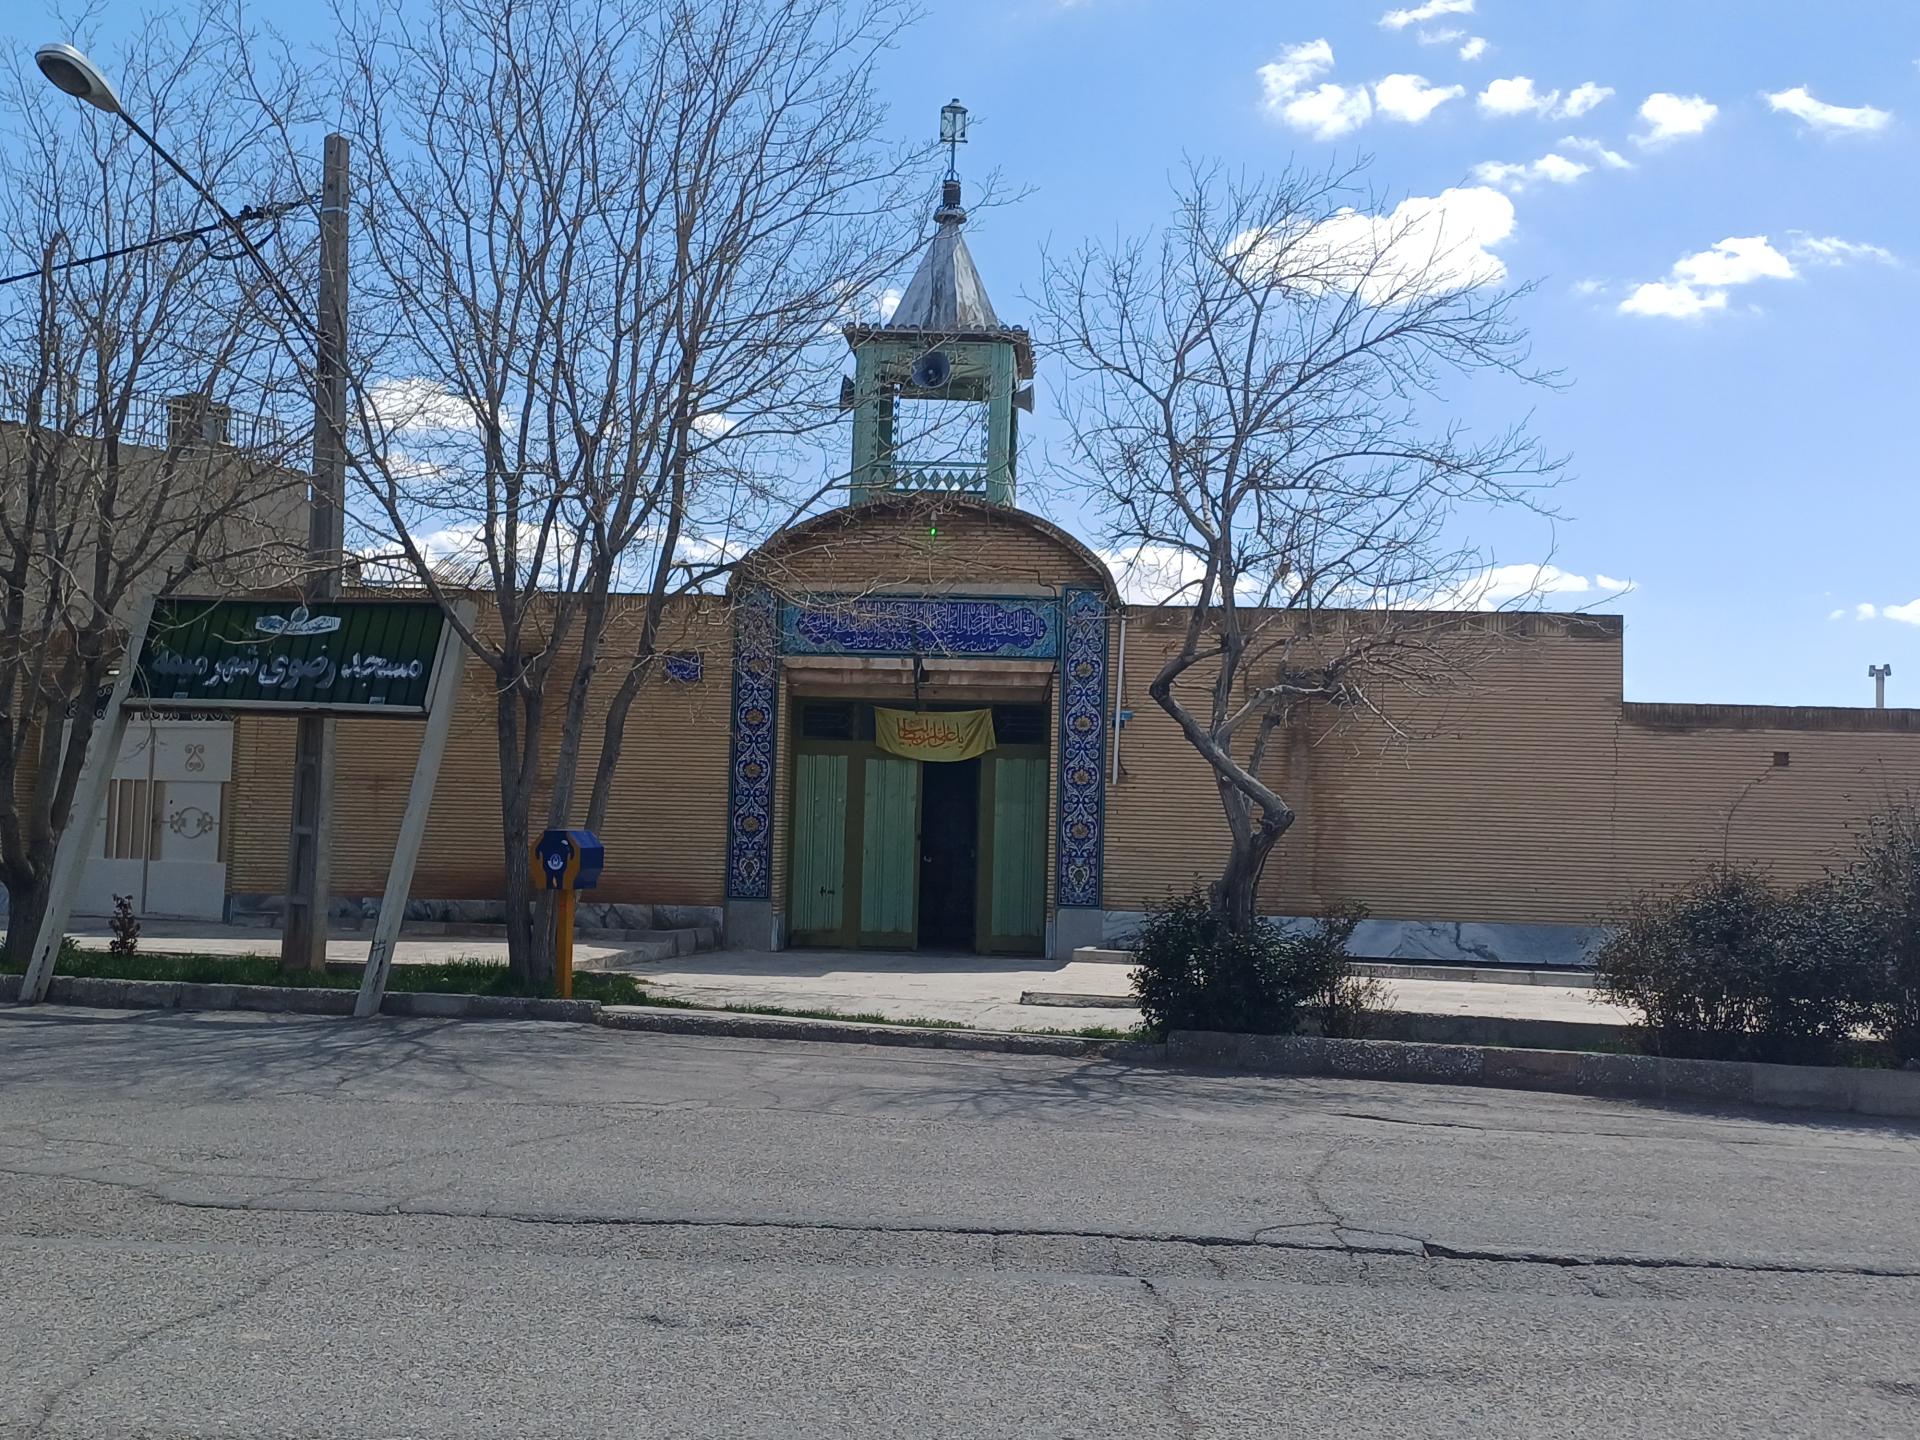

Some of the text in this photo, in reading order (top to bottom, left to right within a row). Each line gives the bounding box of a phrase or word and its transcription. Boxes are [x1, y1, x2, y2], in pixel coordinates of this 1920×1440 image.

[203, 646, 259, 687] شهر
[258, 645, 336, 689] رضوی
[341, 652, 423, 687] مسجد
